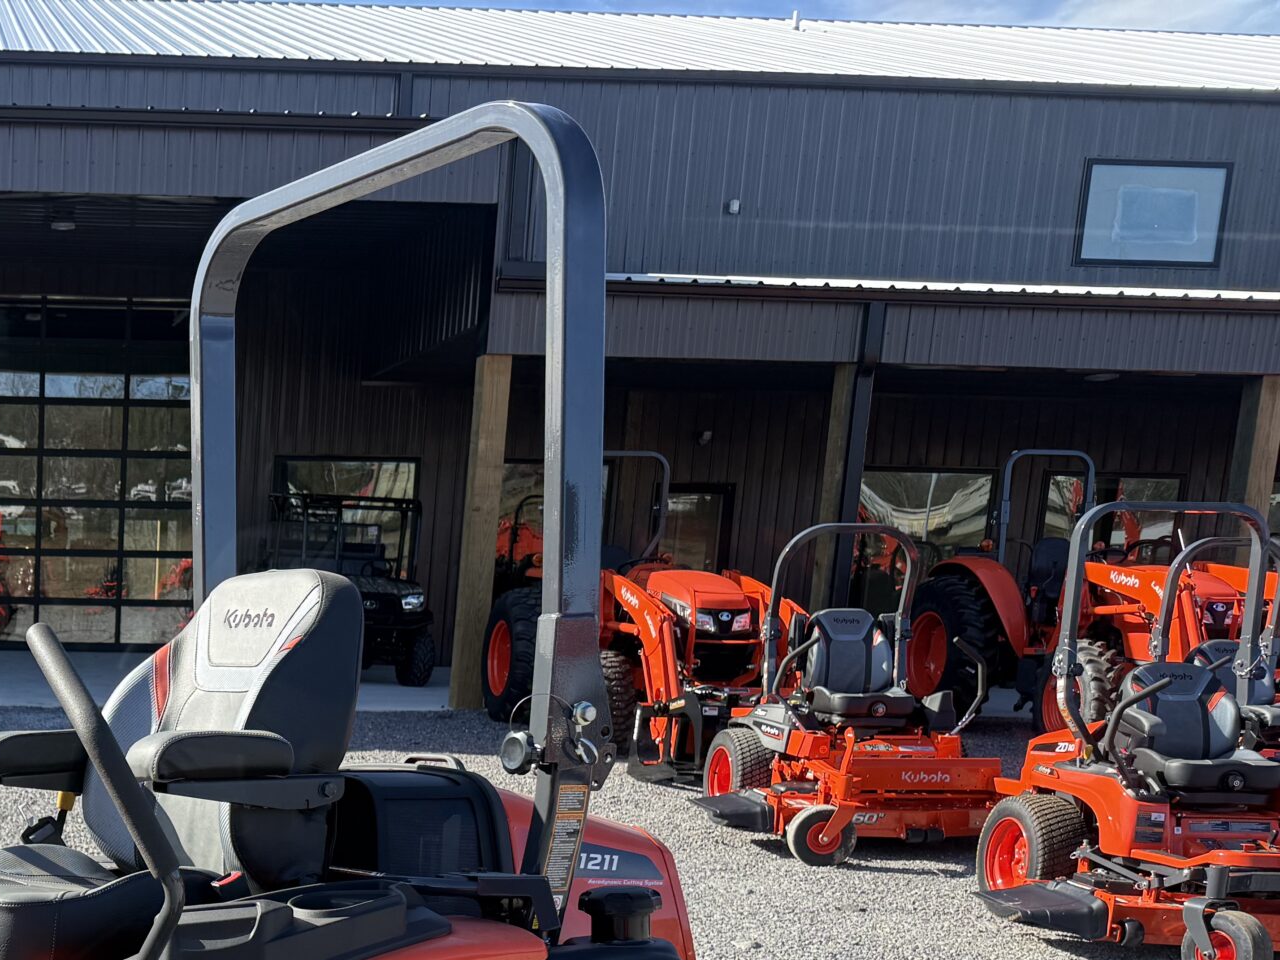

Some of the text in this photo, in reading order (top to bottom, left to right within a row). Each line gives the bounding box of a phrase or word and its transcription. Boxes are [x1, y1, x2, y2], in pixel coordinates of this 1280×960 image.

[1109, 570, 1140, 588] Kubota
[223, 607, 275, 629] Kubota
[833, 616, 861, 625] Kubota
[901, 770, 951, 783] Kubota
[579, 852, 619, 871] 1211
